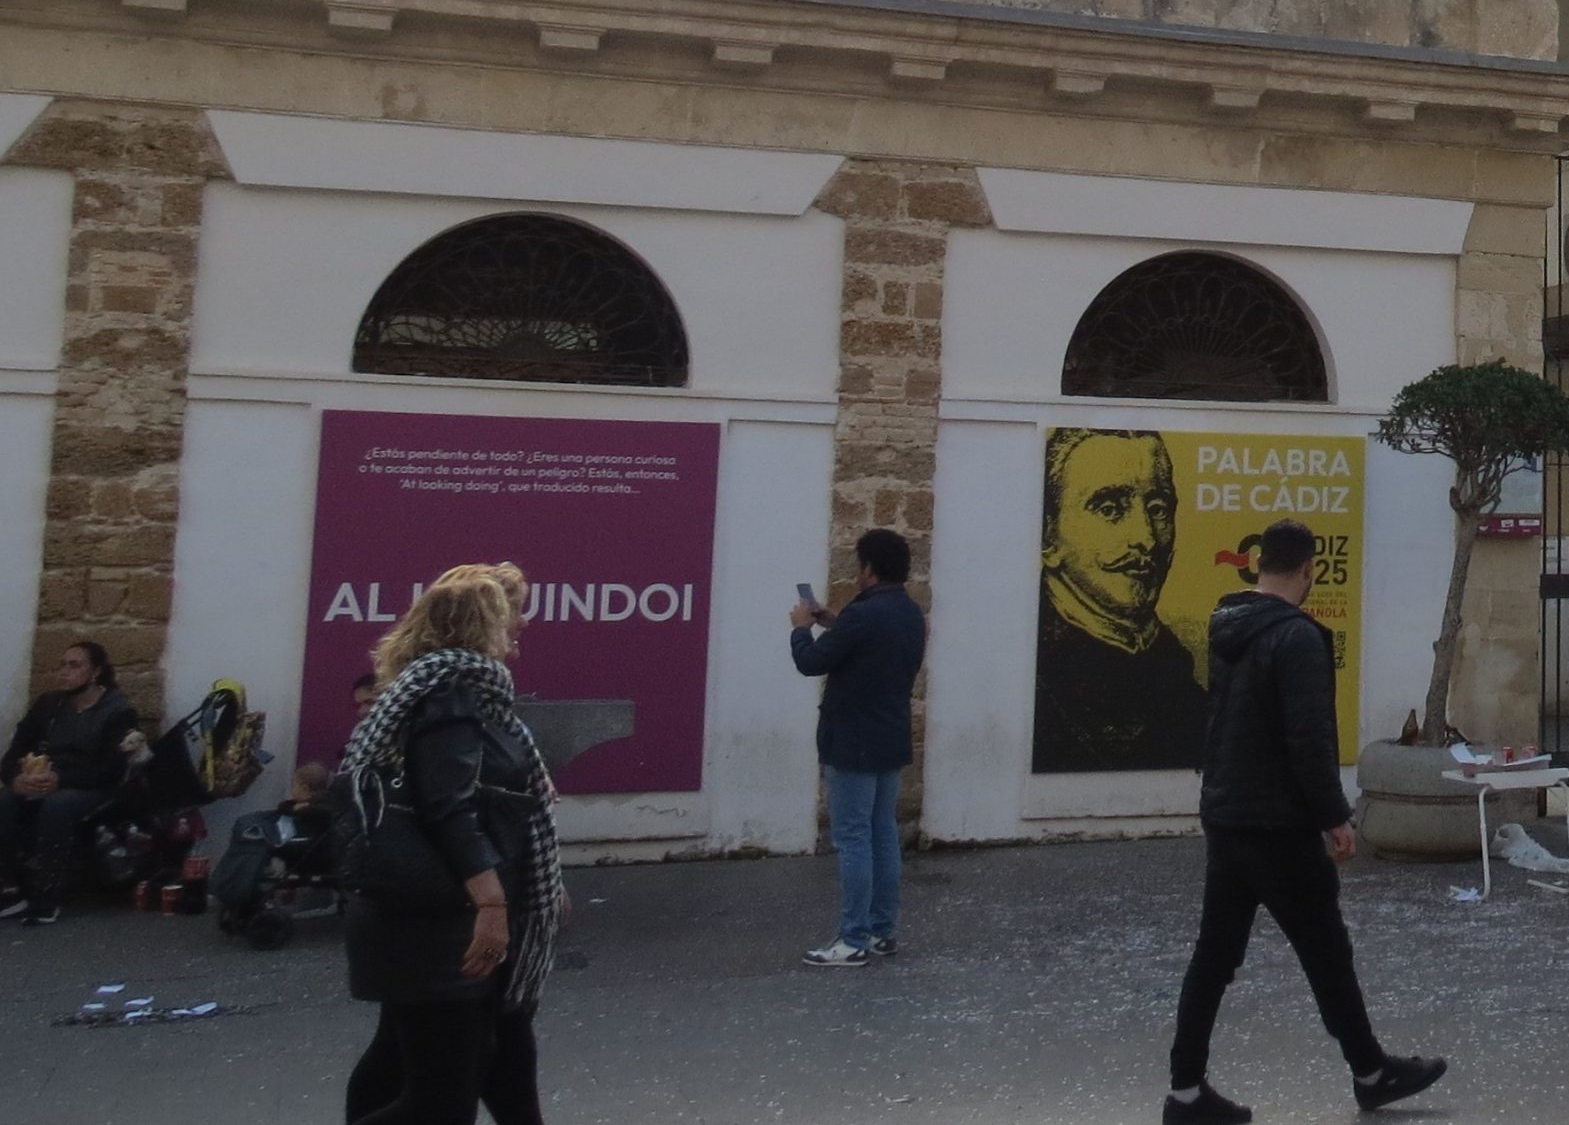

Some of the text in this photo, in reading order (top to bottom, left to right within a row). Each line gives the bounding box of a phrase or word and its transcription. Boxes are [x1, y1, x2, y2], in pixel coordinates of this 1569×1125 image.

[408, 449, 470, 461] pendiente
[471, 450, 488, 461] de
[489, 451, 525, 462] todo?
[561, 455, 583, 463] una
[585, 454, 633, 465] persona
[634, 455, 676, 464] curiosa
[1198, 446, 1350, 476] PALABRA
[358, 464, 368, 473] o
[370, 464, 383, 473] te
[384, 464, 432, 474] acaban
[434, 465, 450, 474] de
[452, 465, 502, 475] advertir
[503, 466, 520, 476] de
[521, 469, 536, 477] un
[538, 467, 587, 480] peligro?
[418, 479, 462, 493] looking
[508, 484, 530, 493] que
[533, 482, 591, 493] traducido
[1197, 476, 1350, 513] DE CÁDIZ
[323, 582, 397, 622] AL
